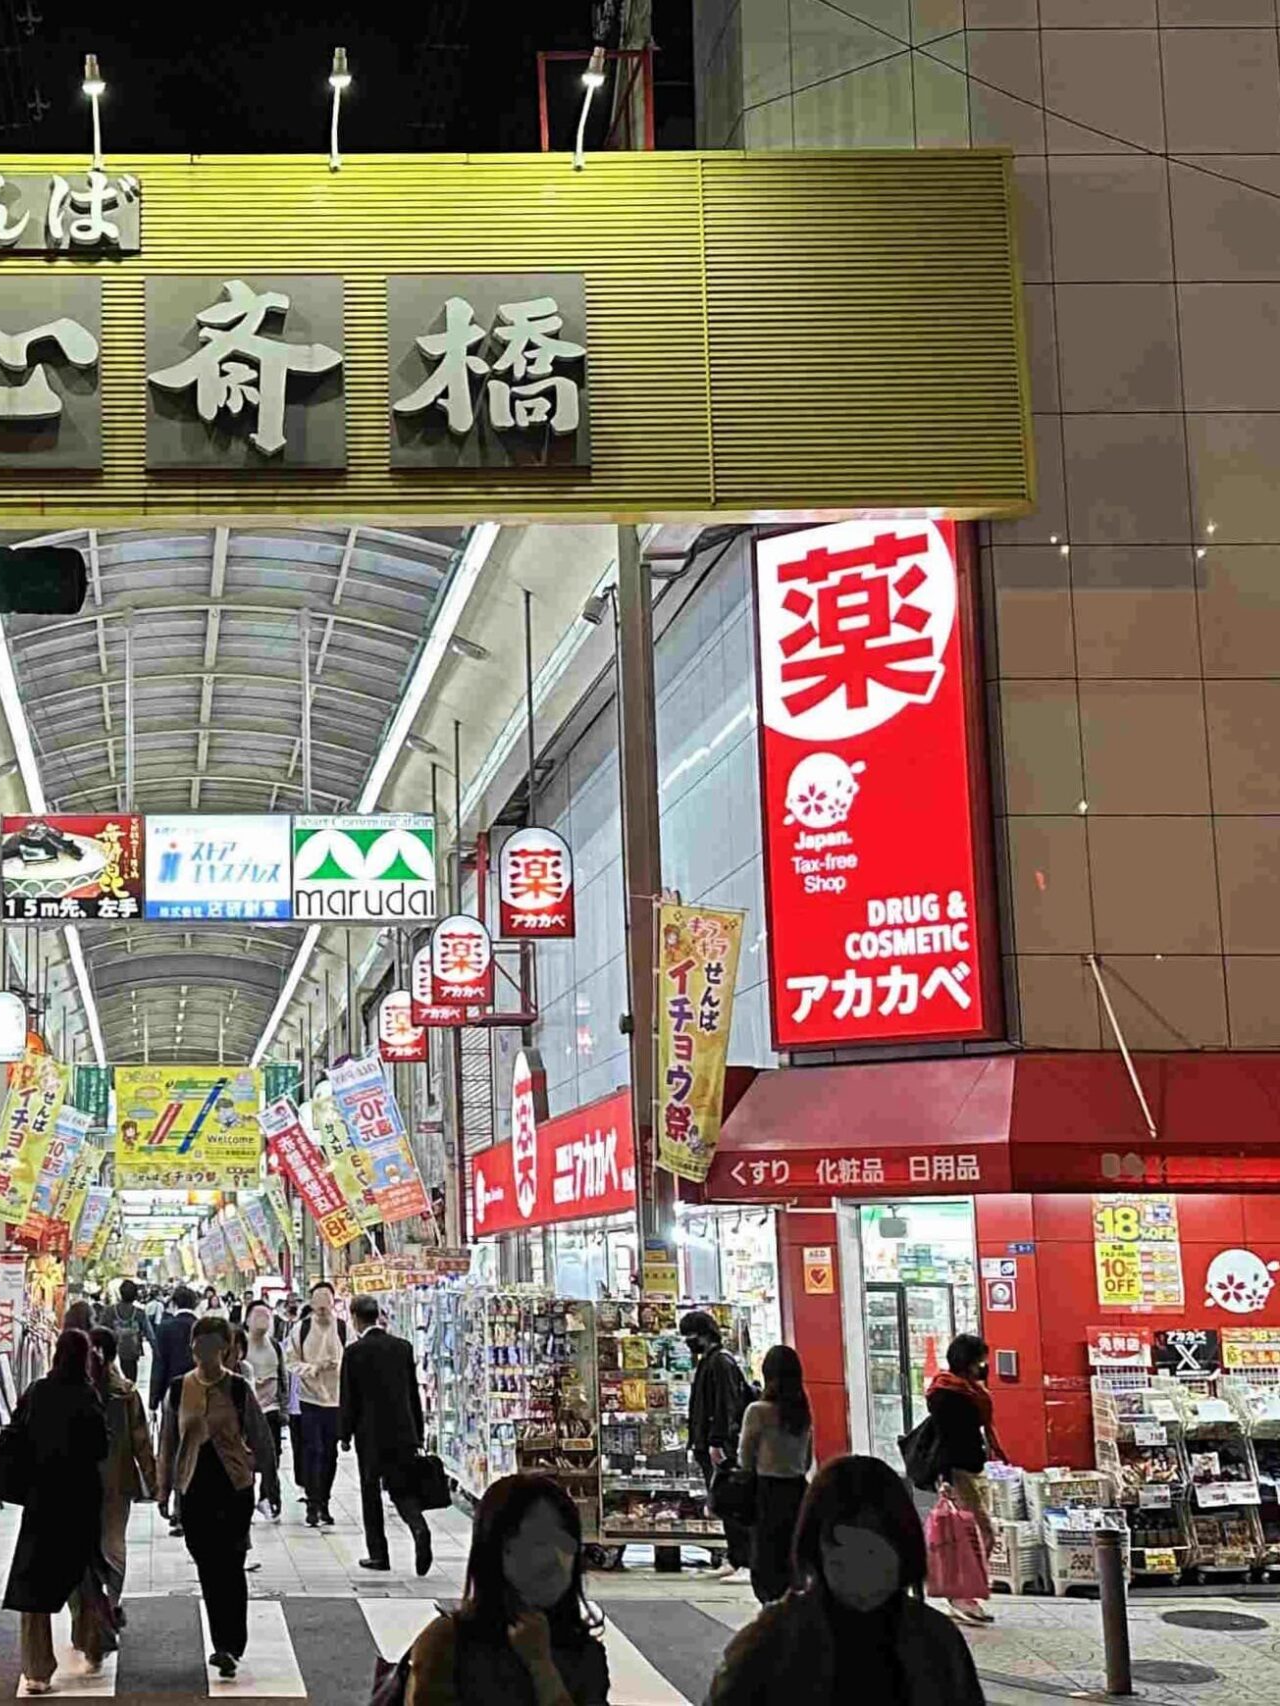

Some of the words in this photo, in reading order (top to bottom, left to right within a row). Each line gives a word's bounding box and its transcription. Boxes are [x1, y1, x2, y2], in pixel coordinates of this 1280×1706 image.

[777, 533, 935, 718] 薬
[509, 848, 563, 900] 薬
[790, 852, 858, 875] Tax-free
[295, 883, 434, 916] marudai
[804, 874, 846, 895] Shop
[510, 913, 566, 929] アカカベ
[867, 896, 939, 928] DRUG
[945, 890, 968, 917] &
[439, 932, 484, 975] 薬
[844, 924, 969, 960] COSMETIC
[439, 984, 486, 999] アカカベ
[699, 961, 724, 1032] せんば
[786, 960, 972, 1024] アカカベ
[207, 1134, 256, 1144] Welcome
[571, 1126, 618, 1201] アカカベ
[731, 1159, 790, 1186] くすり
[816, 1157, 885, 1185] 化粧品
[908, 1154, 981, 1182] 日用品
[1104, 1279, 1136, 1292] OFF
